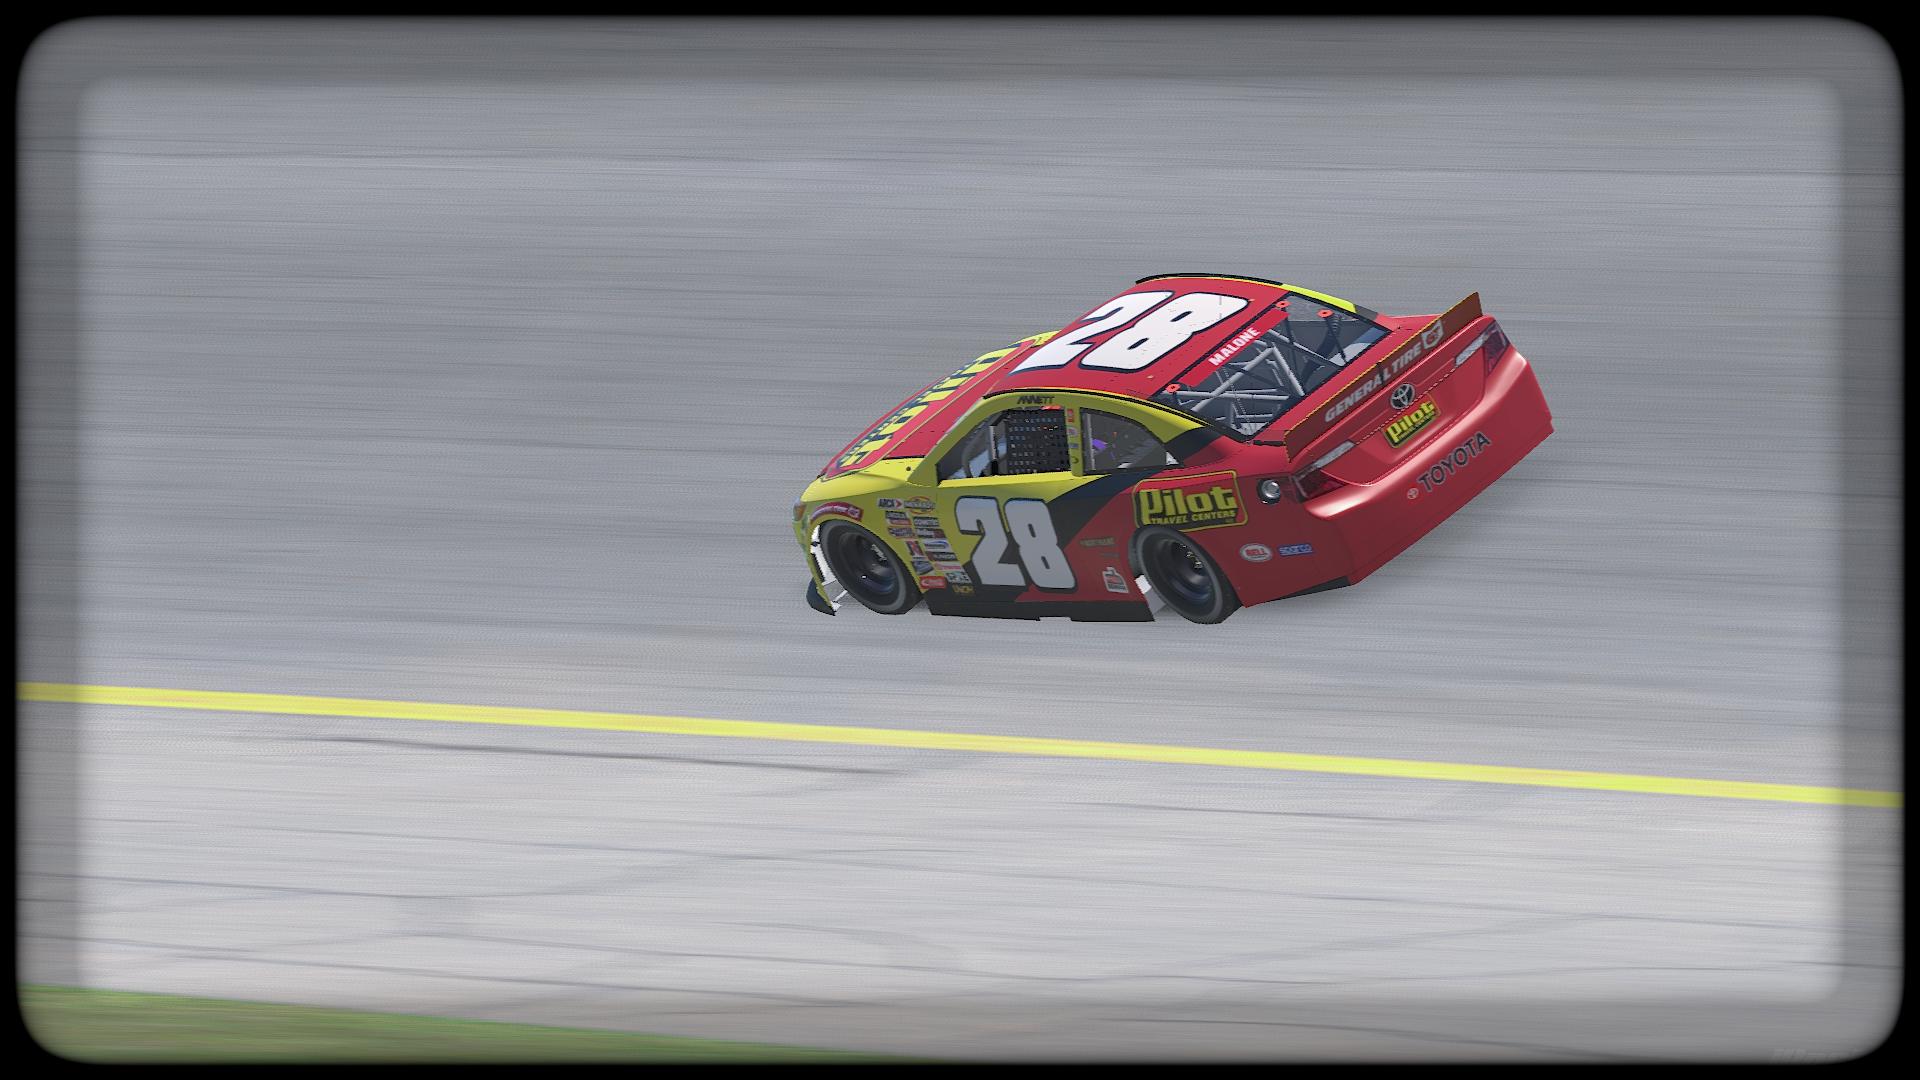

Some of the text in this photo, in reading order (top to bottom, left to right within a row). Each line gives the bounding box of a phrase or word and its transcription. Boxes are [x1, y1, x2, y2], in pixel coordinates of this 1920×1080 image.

[1009, 290, 1249, 373] 28
[1208, 327, 1262, 367] MALONE
[1323, 343, 1423, 424] GENERAL TIRE
[1386, 401, 1435, 443] Pilot
[1418, 430, 1492, 493] TOYOTA
[1139, 486, 1238, 525] Pilot
[1151, 514, 1189, 525] TRAVEL
[1191, 510, 1237, 522] CENTERS
[955, 495, 1078, 590] 28
